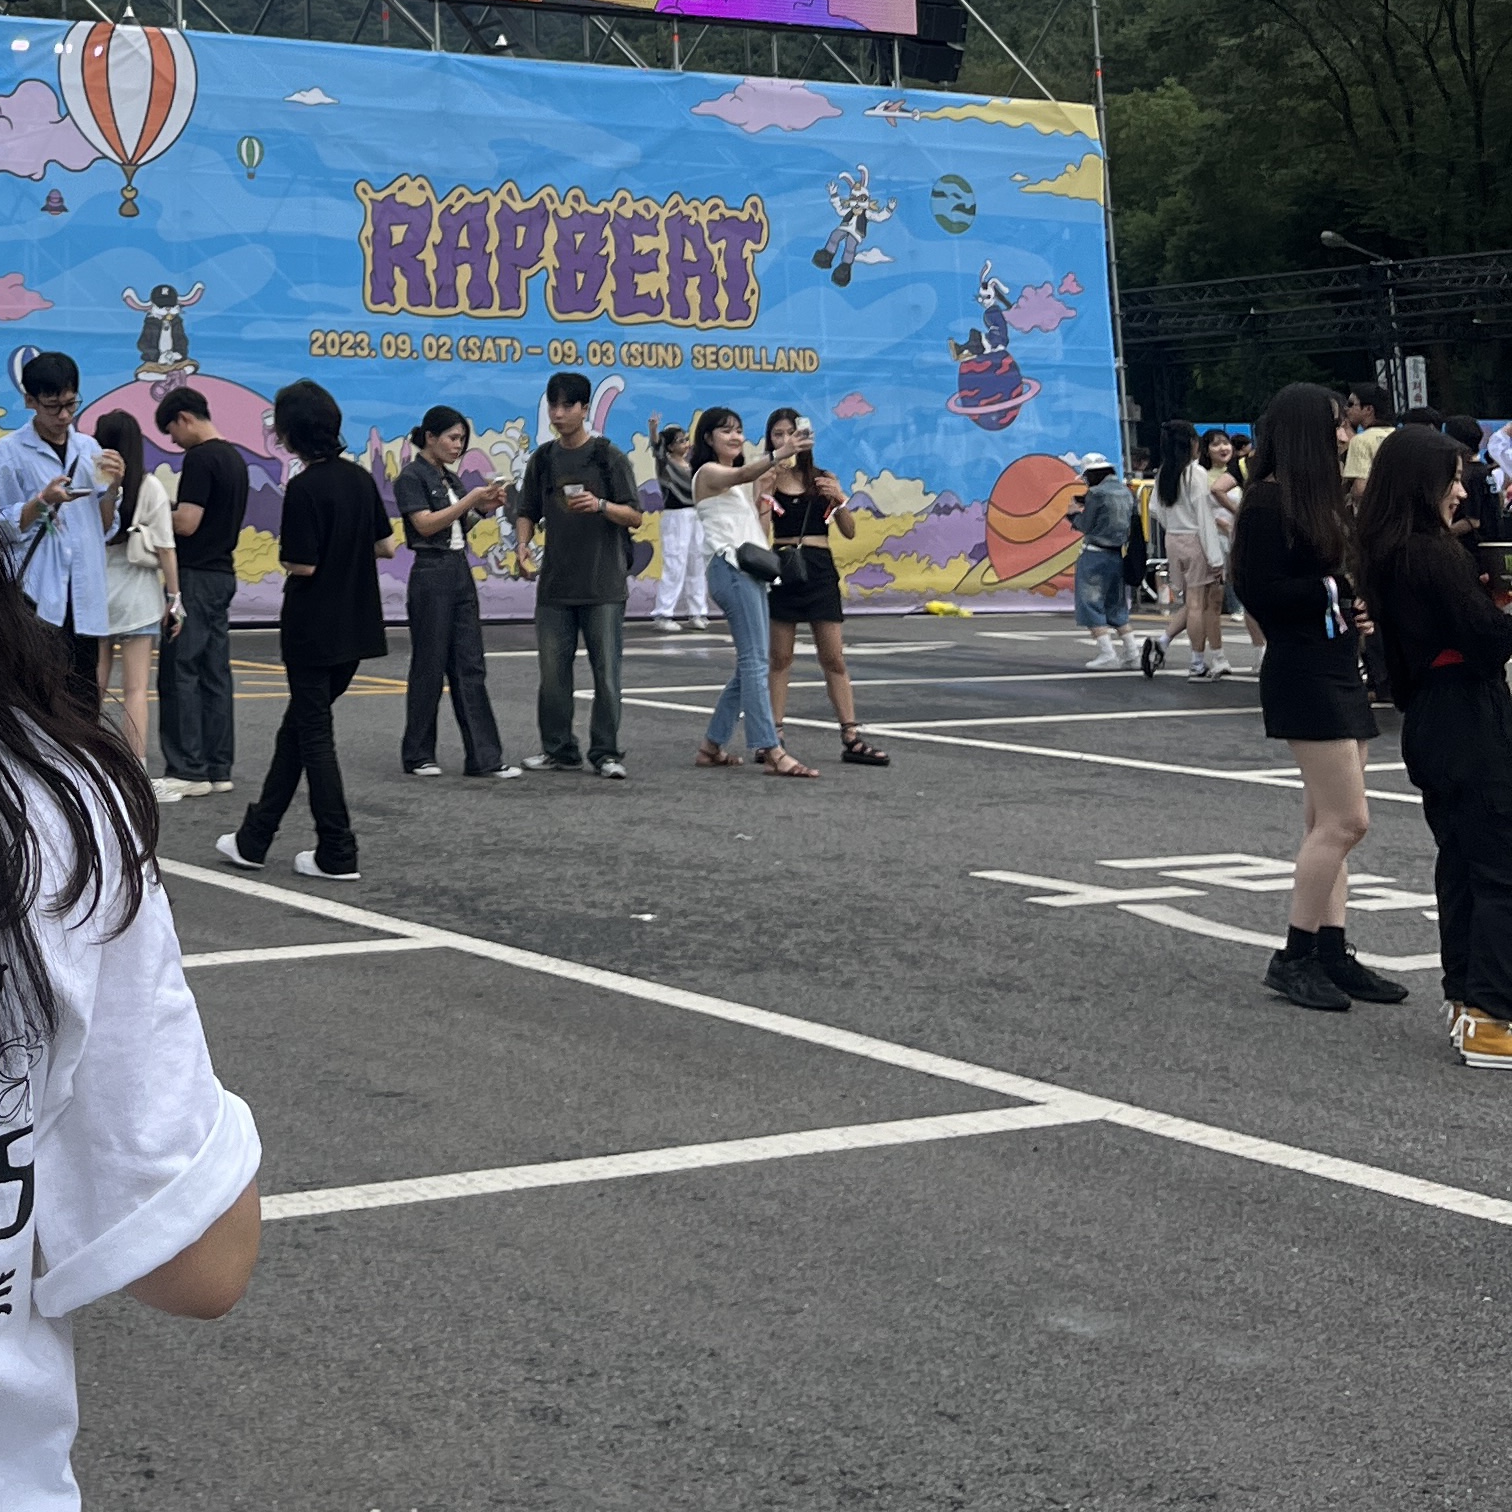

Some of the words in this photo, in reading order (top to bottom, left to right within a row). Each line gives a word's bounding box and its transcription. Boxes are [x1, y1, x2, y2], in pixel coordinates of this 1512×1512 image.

[360, 178, 768, 328] RAPBEAT
[309, 329, 377, 358] 2023.
[381, 332, 419, 360] 09.
[421, 333, 454, 362] 02
[457, 335, 522, 363] (SAT)
[547, 338, 583, 366] 09.
[586, 339, 616, 367] 03
[619, 341, 684, 369] (SUN)
[691, 343, 820, 373] SEOULLAND
